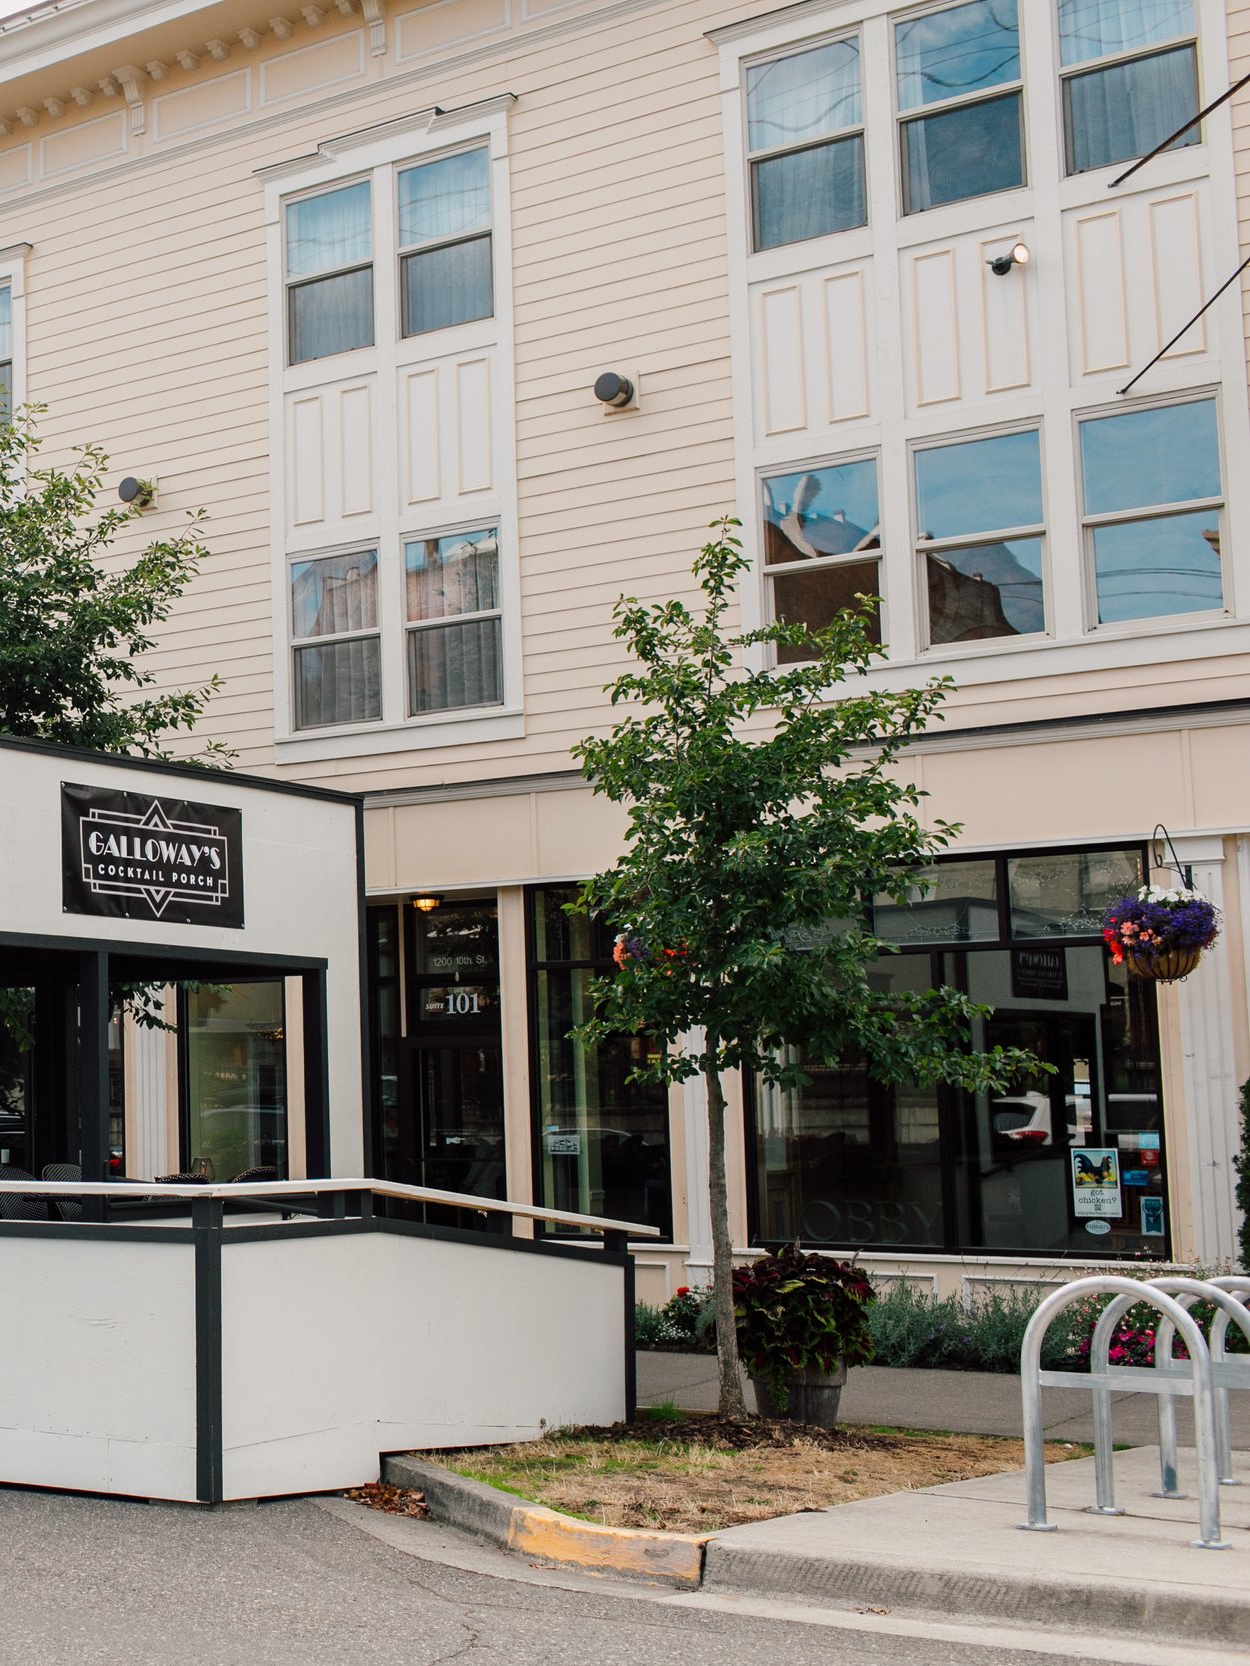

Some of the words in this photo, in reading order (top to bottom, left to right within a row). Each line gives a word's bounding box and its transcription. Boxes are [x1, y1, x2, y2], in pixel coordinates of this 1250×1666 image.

[88, 831, 221, 870] GALLOWAY'S
[98, 864, 165, 882] COCKTAIL
[172, 871, 213, 887] PORCH
[433, 956, 452, 967] 1200
[425, 1002, 445, 1010] SUITE
[446, 992, 481, 1014] 101
[1078, 1196, 1117, 1204] chicken?
[1090, 1189, 1104, 1197] got
